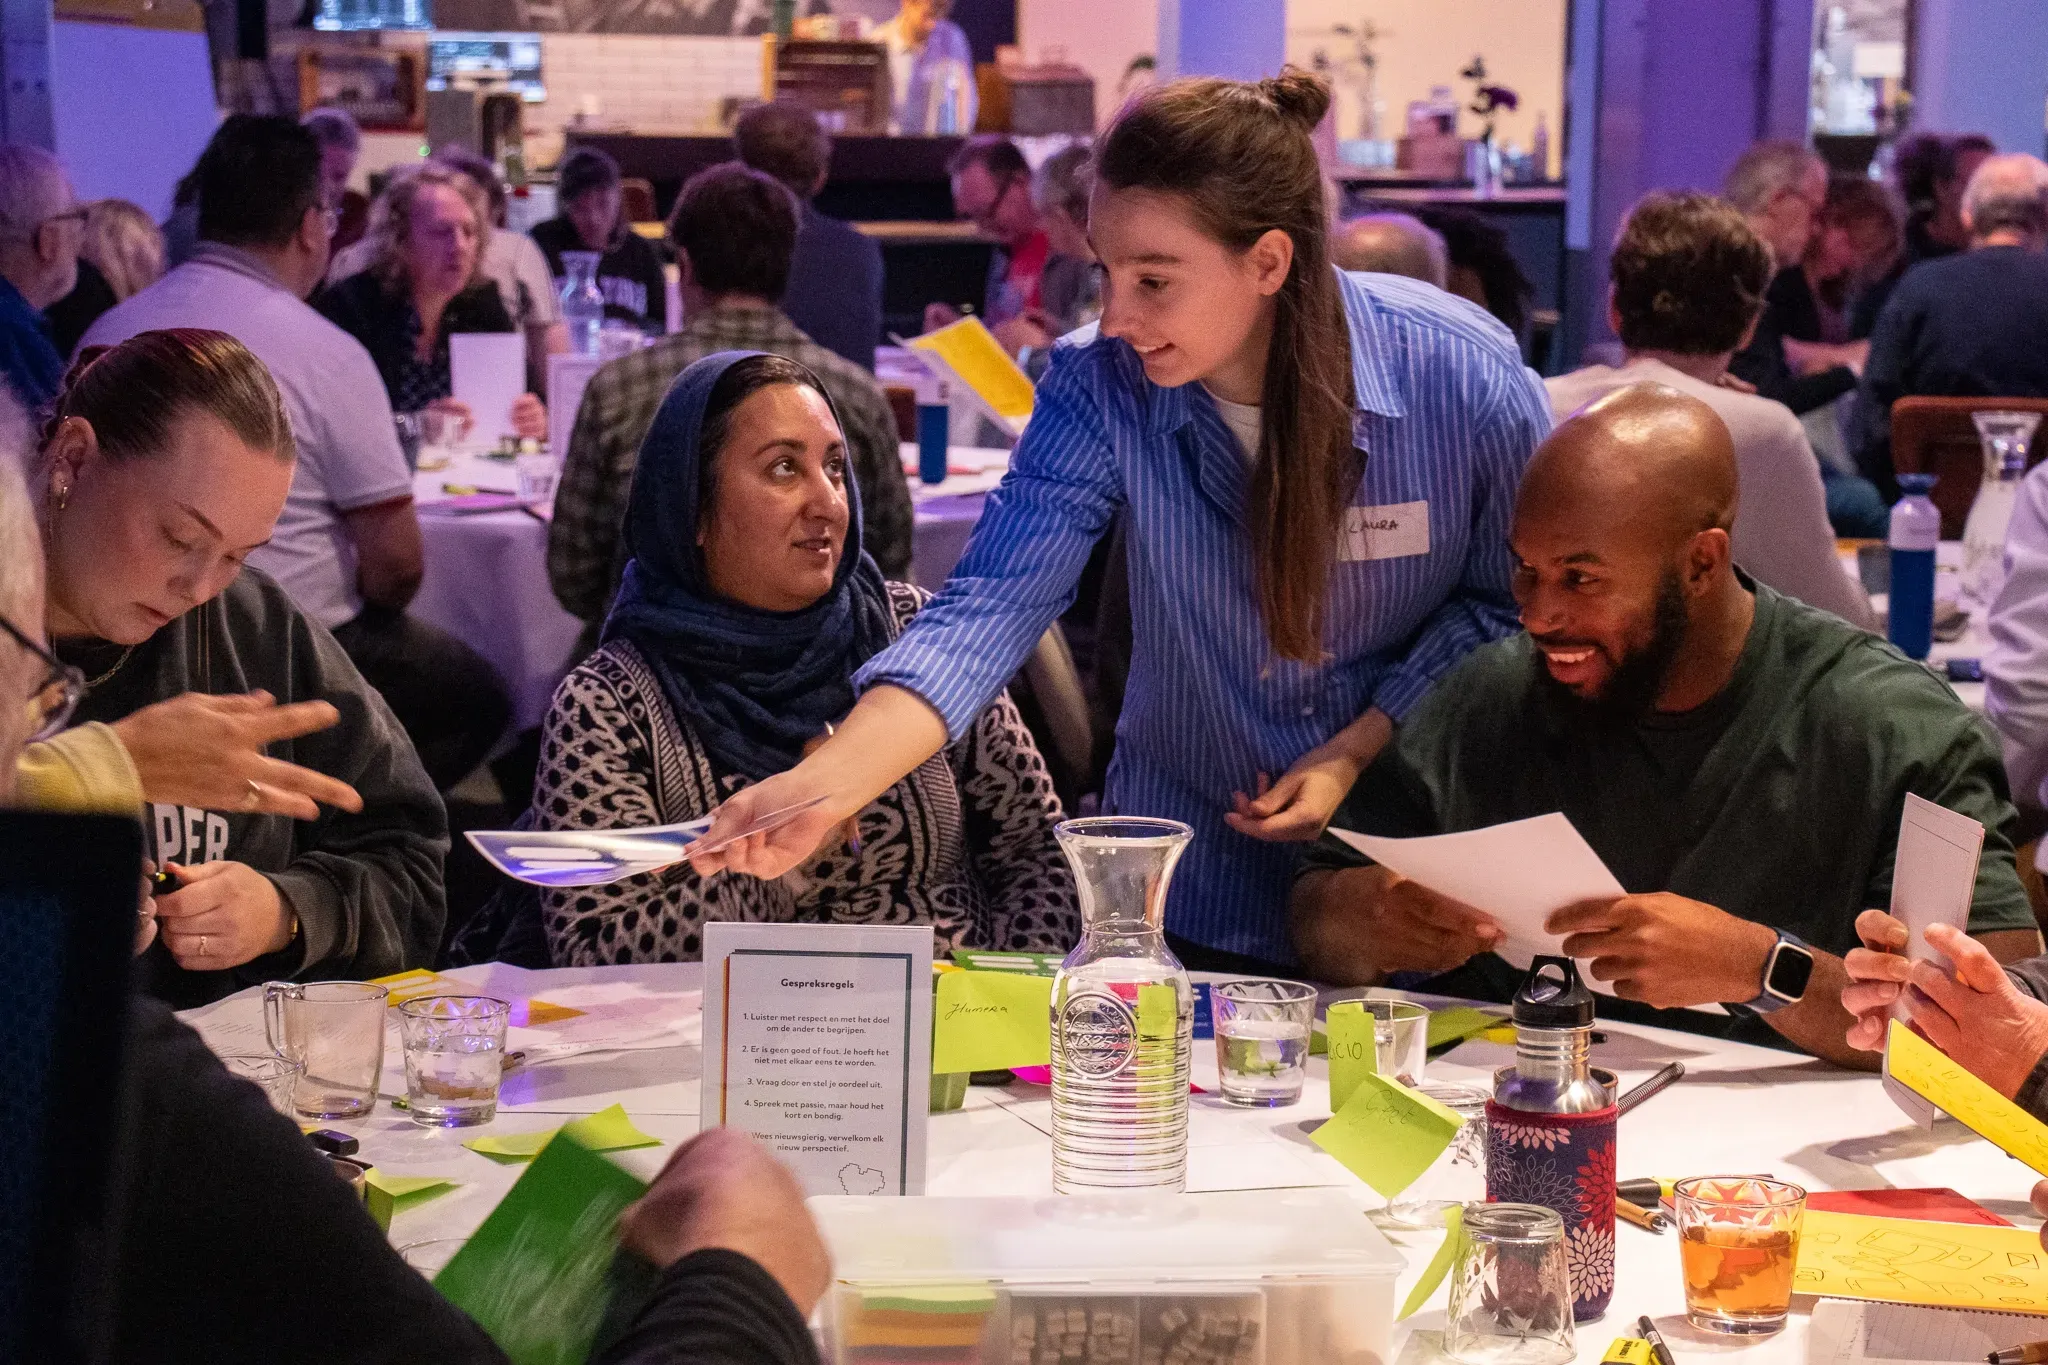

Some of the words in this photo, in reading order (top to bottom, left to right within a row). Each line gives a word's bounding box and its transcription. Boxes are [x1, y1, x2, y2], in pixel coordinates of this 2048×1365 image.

[1349, 519, 1399, 534] LAURA
[145, 803, 229, 872] PER
[781, 978, 854, 989] Gespreksregels
[797, 1015, 827, 1023] respect
[827, 1026, 866, 1034] begrijpen.
[1074, 1034, 1119, 1048] 1825
[791, 1047, 810, 1055] goed
[853, 1048, 874, 1056] hoeft
[756, 1079, 780, 1087] Vraag
[829, 1080, 836, 1088] je
[754, 1100, 780, 1108] Spreek
[815, 1112, 843, 1120] bondig.
[775, 1133, 827, 1142] nieuwsgierig,
